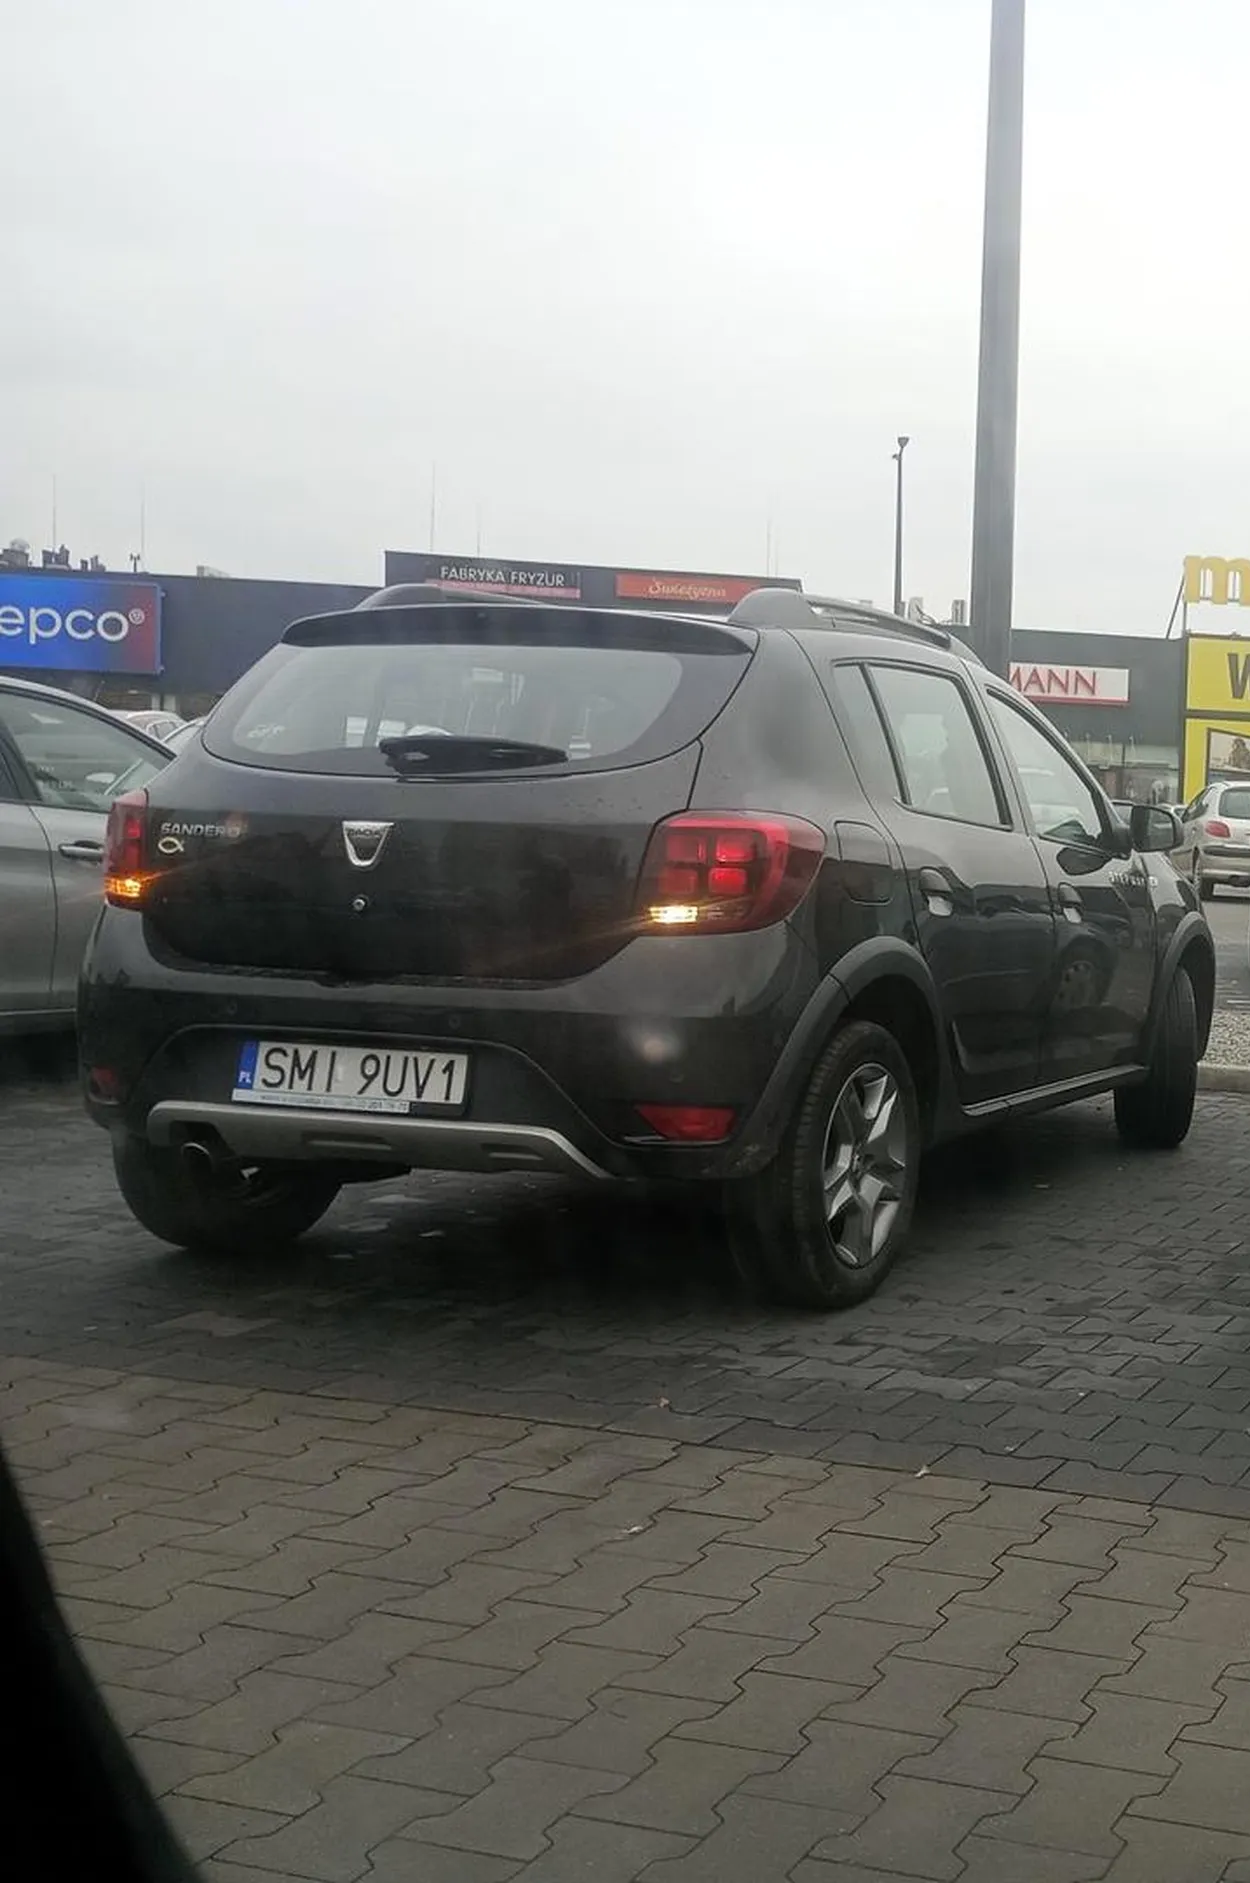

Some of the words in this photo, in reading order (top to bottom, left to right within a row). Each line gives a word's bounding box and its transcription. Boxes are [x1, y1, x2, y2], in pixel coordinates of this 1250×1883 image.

[440, 566, 505, 583] FABRYKA
[510, 571, 565, 587] FRYZUR
[160, 822, 241, 838] SANDERO
[238, 1070, 252, 1084] PL
[261, 1047, 337, 1092] SMI
[357, 1053, 456, 1101] 9UV1
